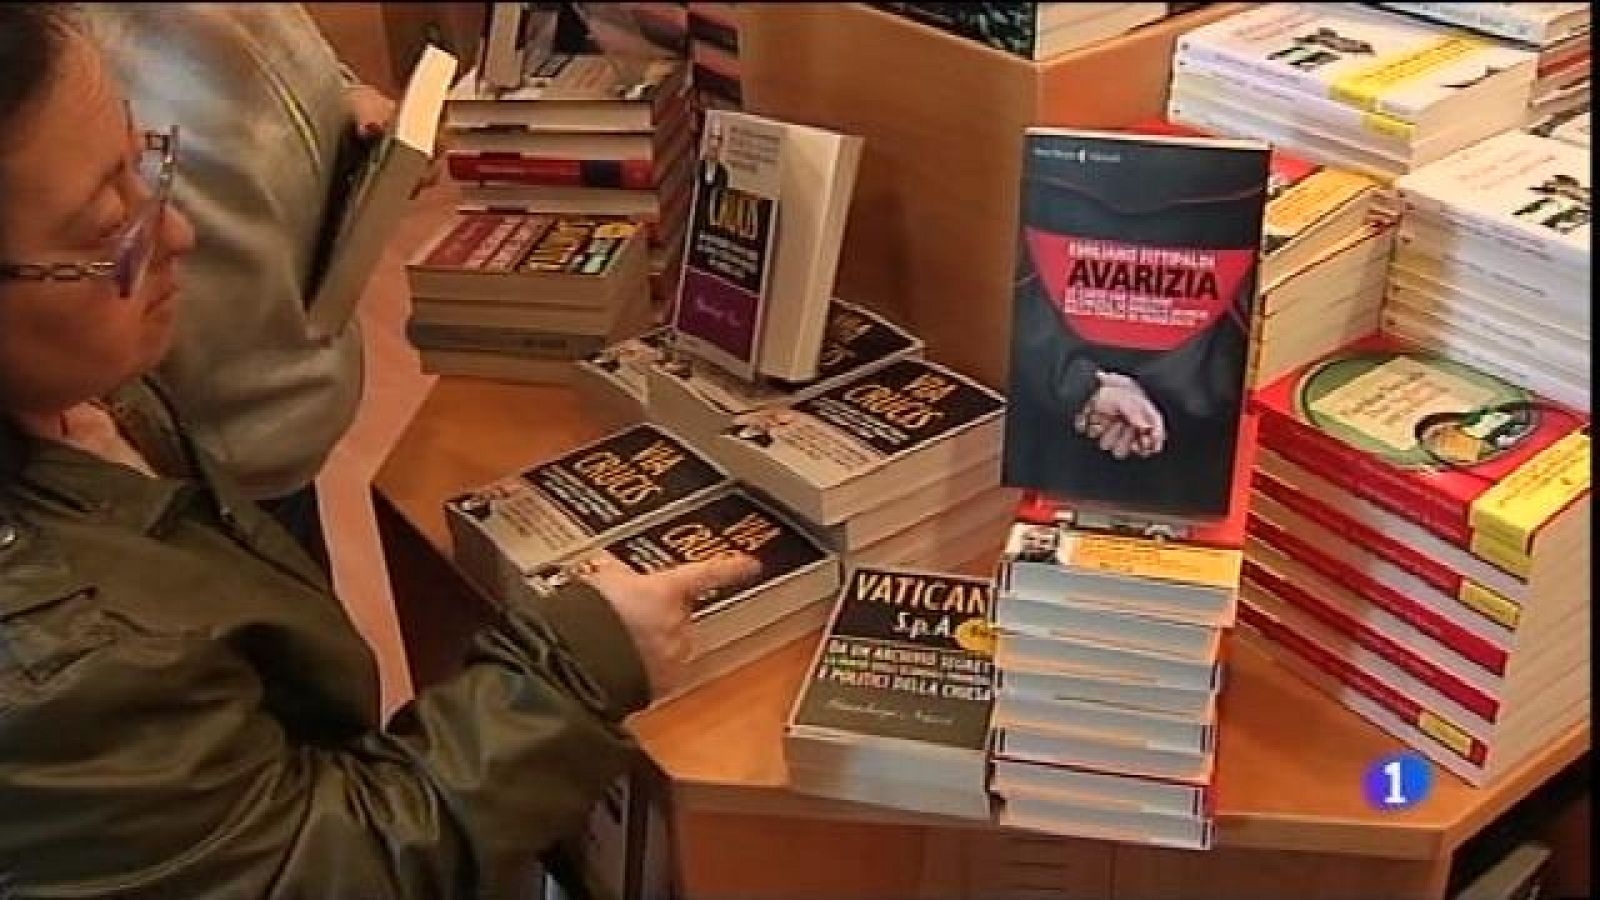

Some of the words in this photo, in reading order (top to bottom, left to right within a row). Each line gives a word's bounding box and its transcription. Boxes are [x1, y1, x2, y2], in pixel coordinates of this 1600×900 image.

[1067, 259, 1218, 301] AVARIZIA
[843, 384, 945, 429] CRUCIS
[902, 373, 958, 403] VIA
[573, 451, 662, 504] CRUCIS
[631, 440, 685, 476] VIA
[722, 511, 781, 551] VIA
